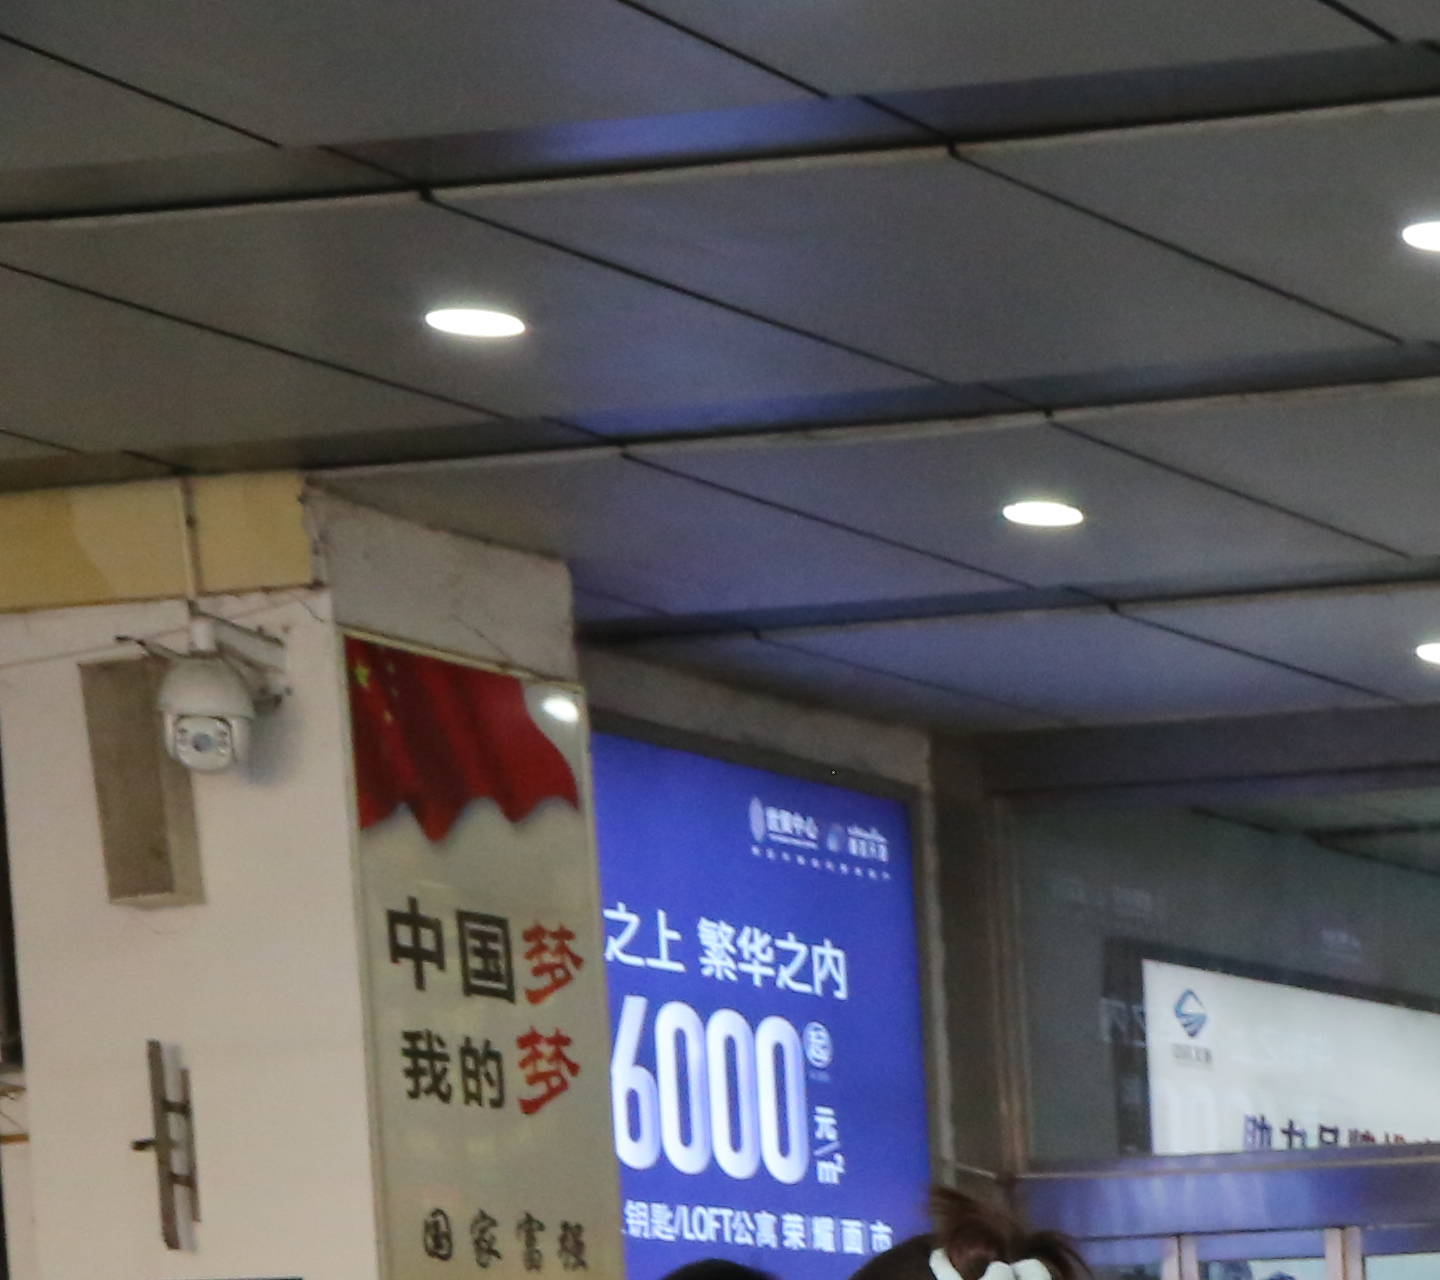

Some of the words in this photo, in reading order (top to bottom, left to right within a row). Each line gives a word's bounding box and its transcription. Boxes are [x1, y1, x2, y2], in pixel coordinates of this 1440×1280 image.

[386, 896, 585, 1006] 中国梦
[602, 901, 686, 973] 之上
[697, 916, 848, 1001] 繁华之内
[401, 1024, 582, 1115] 我的梦
[610, 994, 810, 1185] 6000
[422, 1207, 588, 1272] 国家富强
